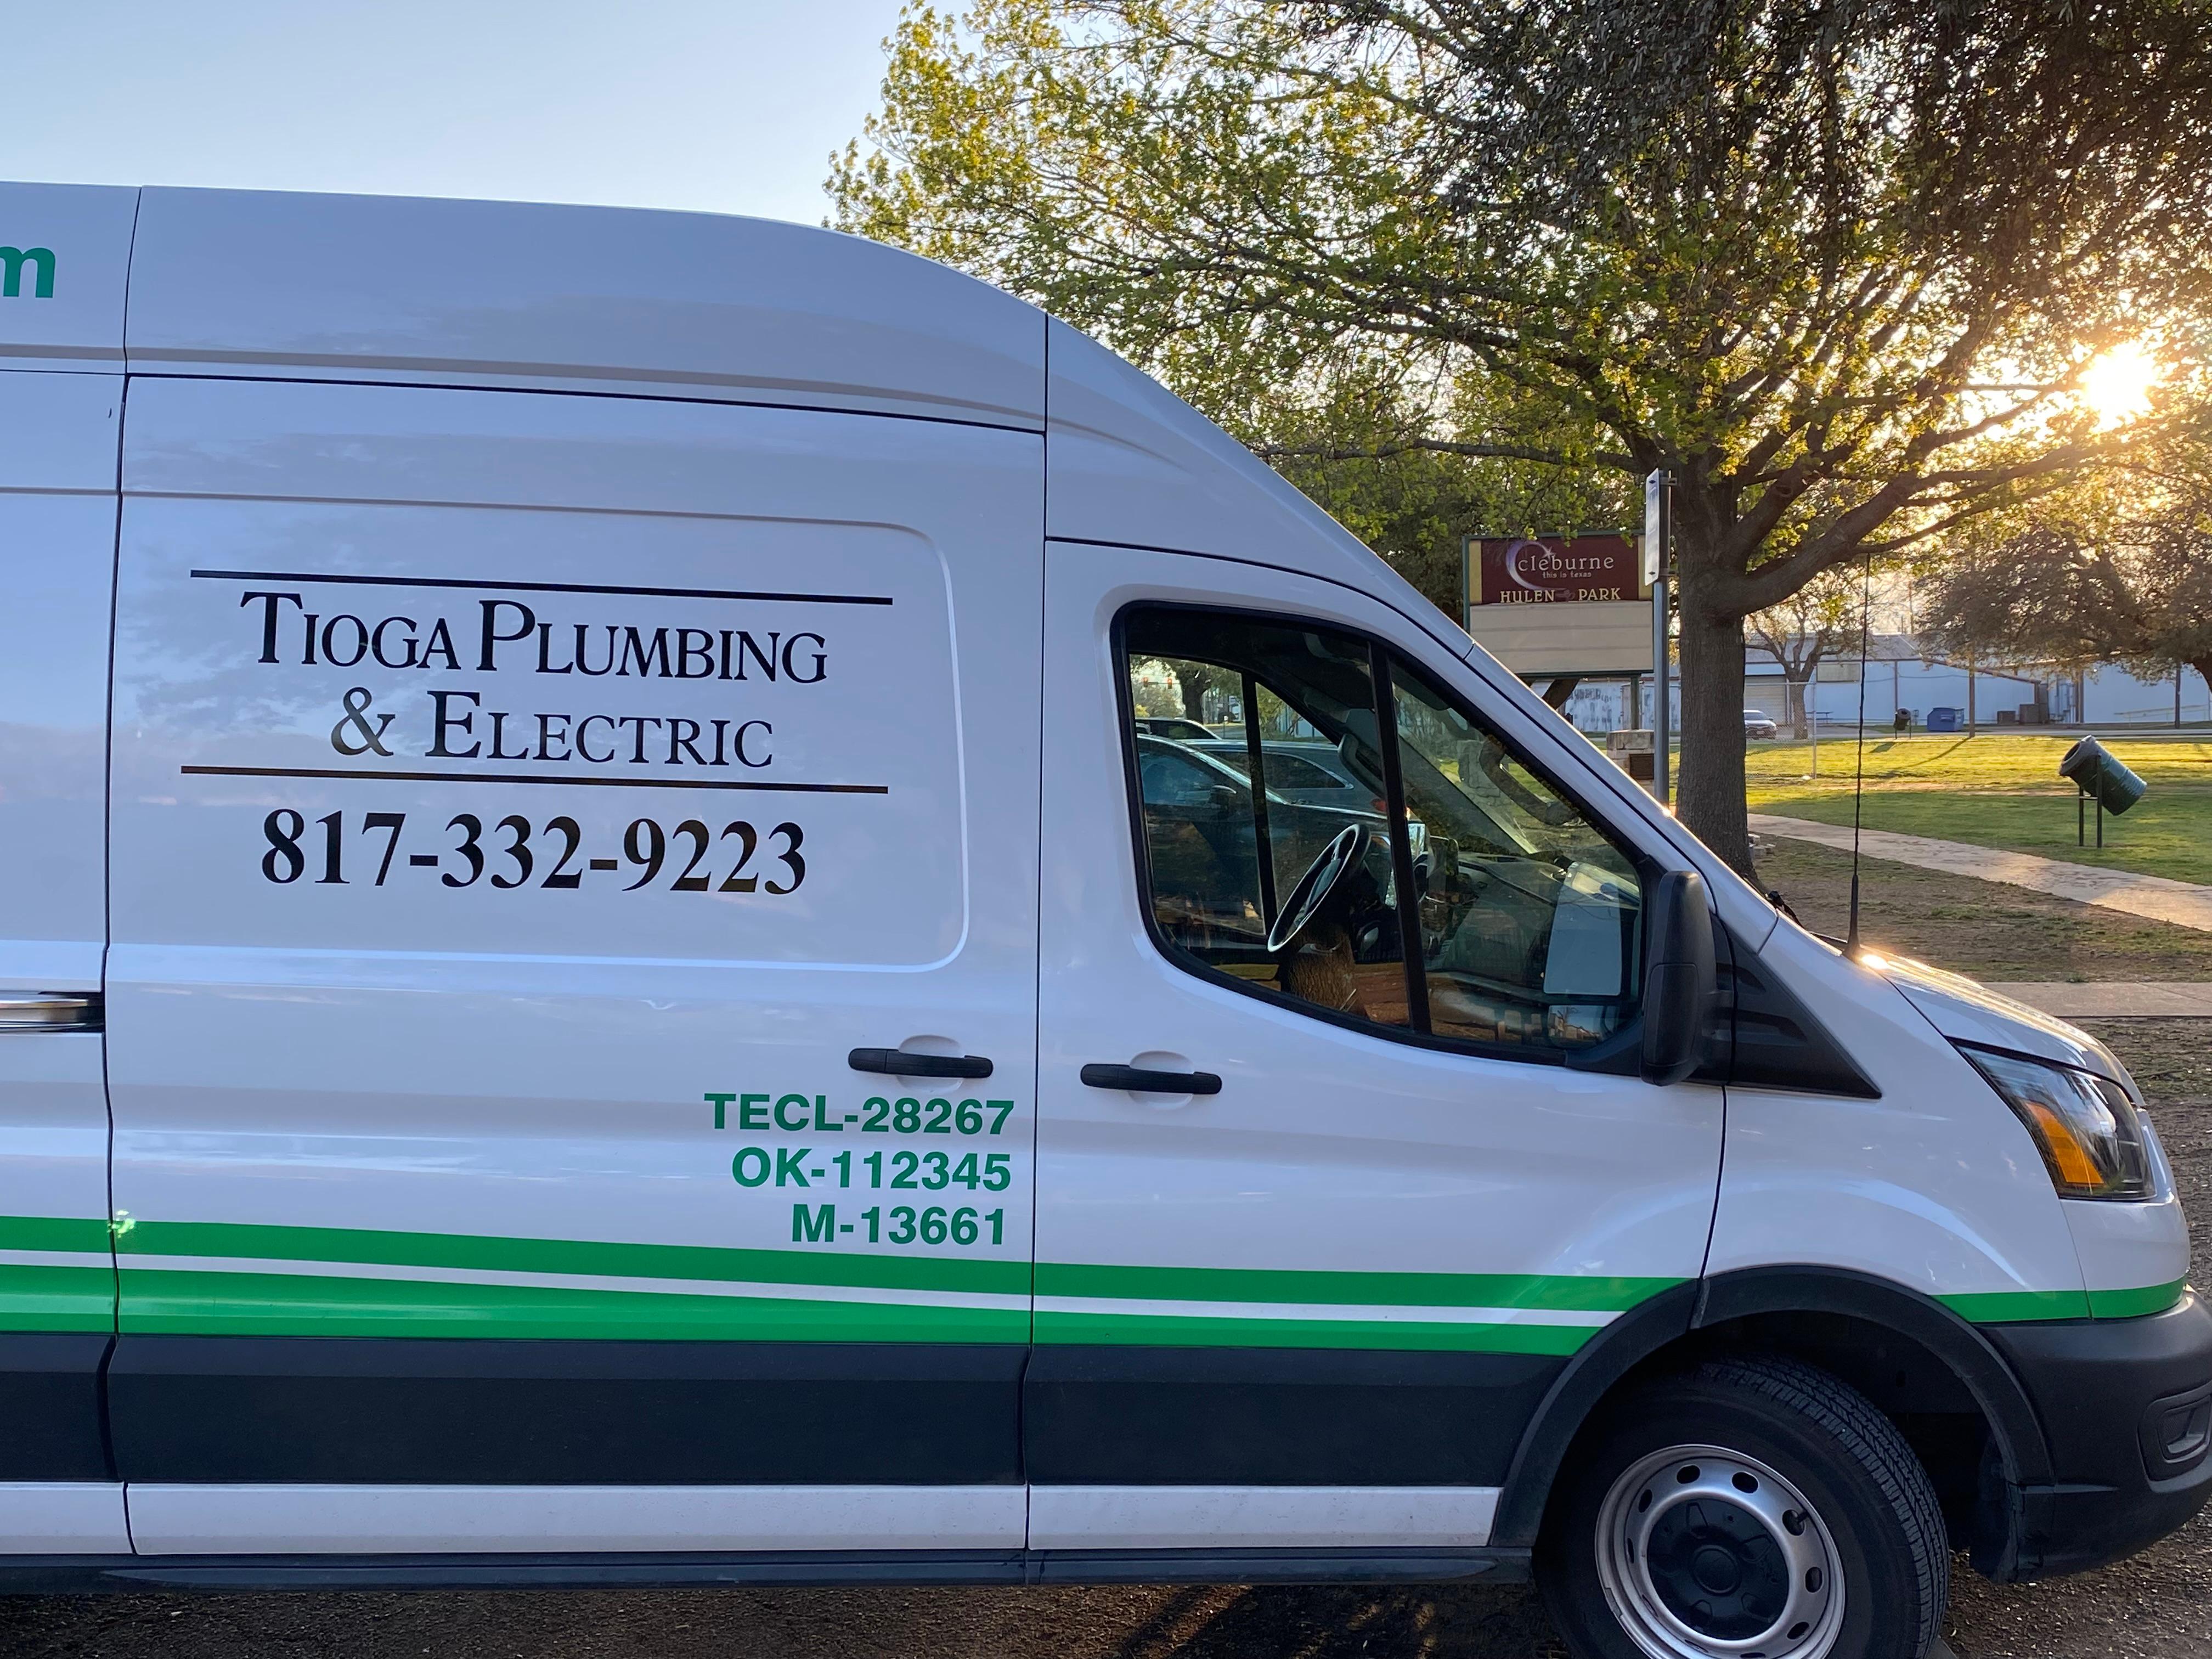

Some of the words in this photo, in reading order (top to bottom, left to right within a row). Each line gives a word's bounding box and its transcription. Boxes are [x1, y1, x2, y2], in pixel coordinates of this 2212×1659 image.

[1518, 554, 1615, 572] cleburne
[1500, 589, 1555, 603] HULEN
[1578, 588, 1621, 601] PARK
[239, 590, 462, 672] TIOGA
[475, 599, 828, 684] PLUMBING
[330, 686, 396, 757] &
[424, 690, 774, 769] ELECTRIC
[261, 808, 807, 895] 817-332-9223
[703, 1092, 1015, 1136] TECL-28267
[731, 1146, 1013, 1193] OK-112345
[791, 1202, 1004, 1246] M-13661
